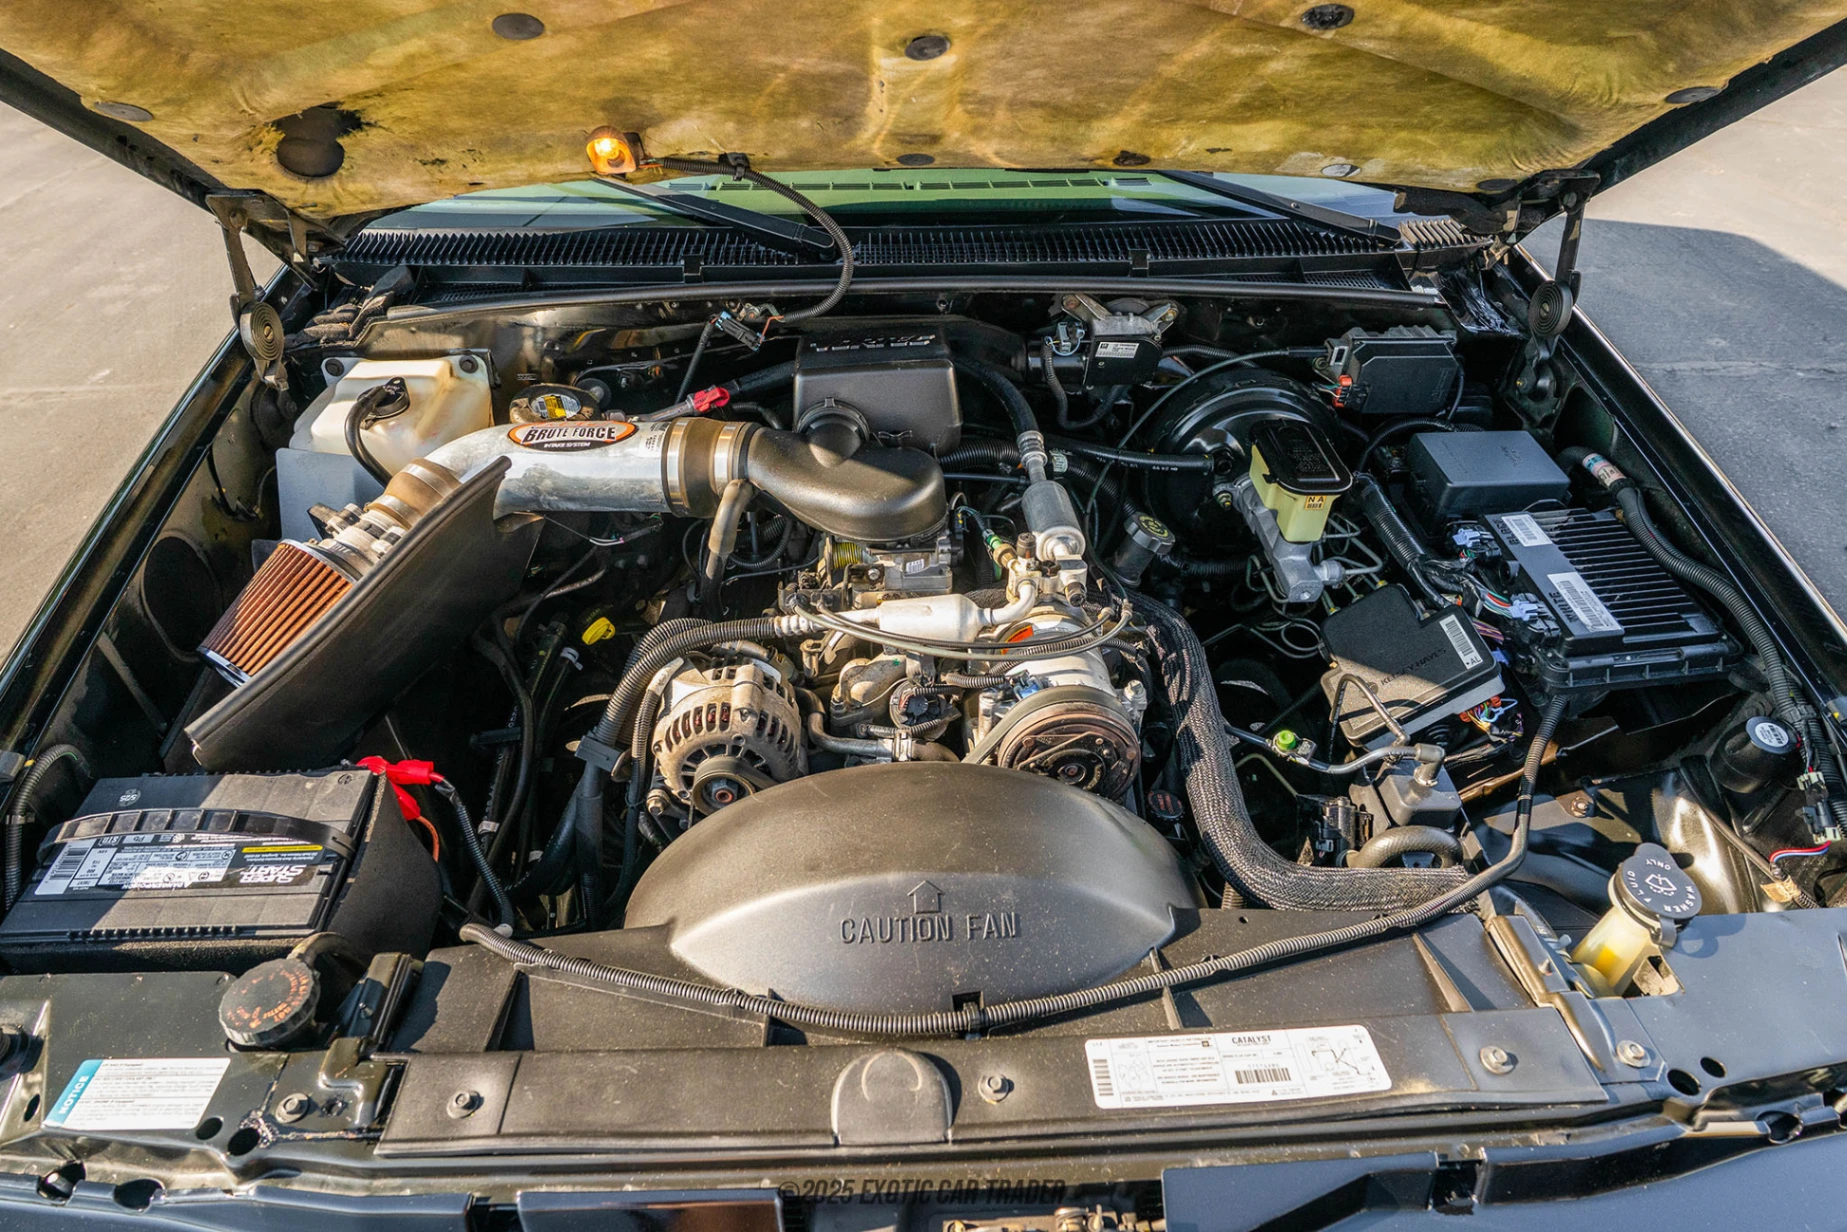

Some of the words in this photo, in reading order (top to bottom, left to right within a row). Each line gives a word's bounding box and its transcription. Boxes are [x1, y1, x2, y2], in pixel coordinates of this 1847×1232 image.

[522, 427, 568, 443] BRUTE
[572, 426, 616, 440] FORCE
[247, 864, 308, 876] START
[1646, 859, 1671, 871] ONLY
[239, 873, 295, 884] SUPER
[1663, 886, 1696, 912] WASHER
[839, 914, 953, 945] CAUTION
[965, 910, 1019, 941] FAN
[1231, 1034, 1272, 1045] CATALYST
[58, 1075, 90, 1115] NOTICE
